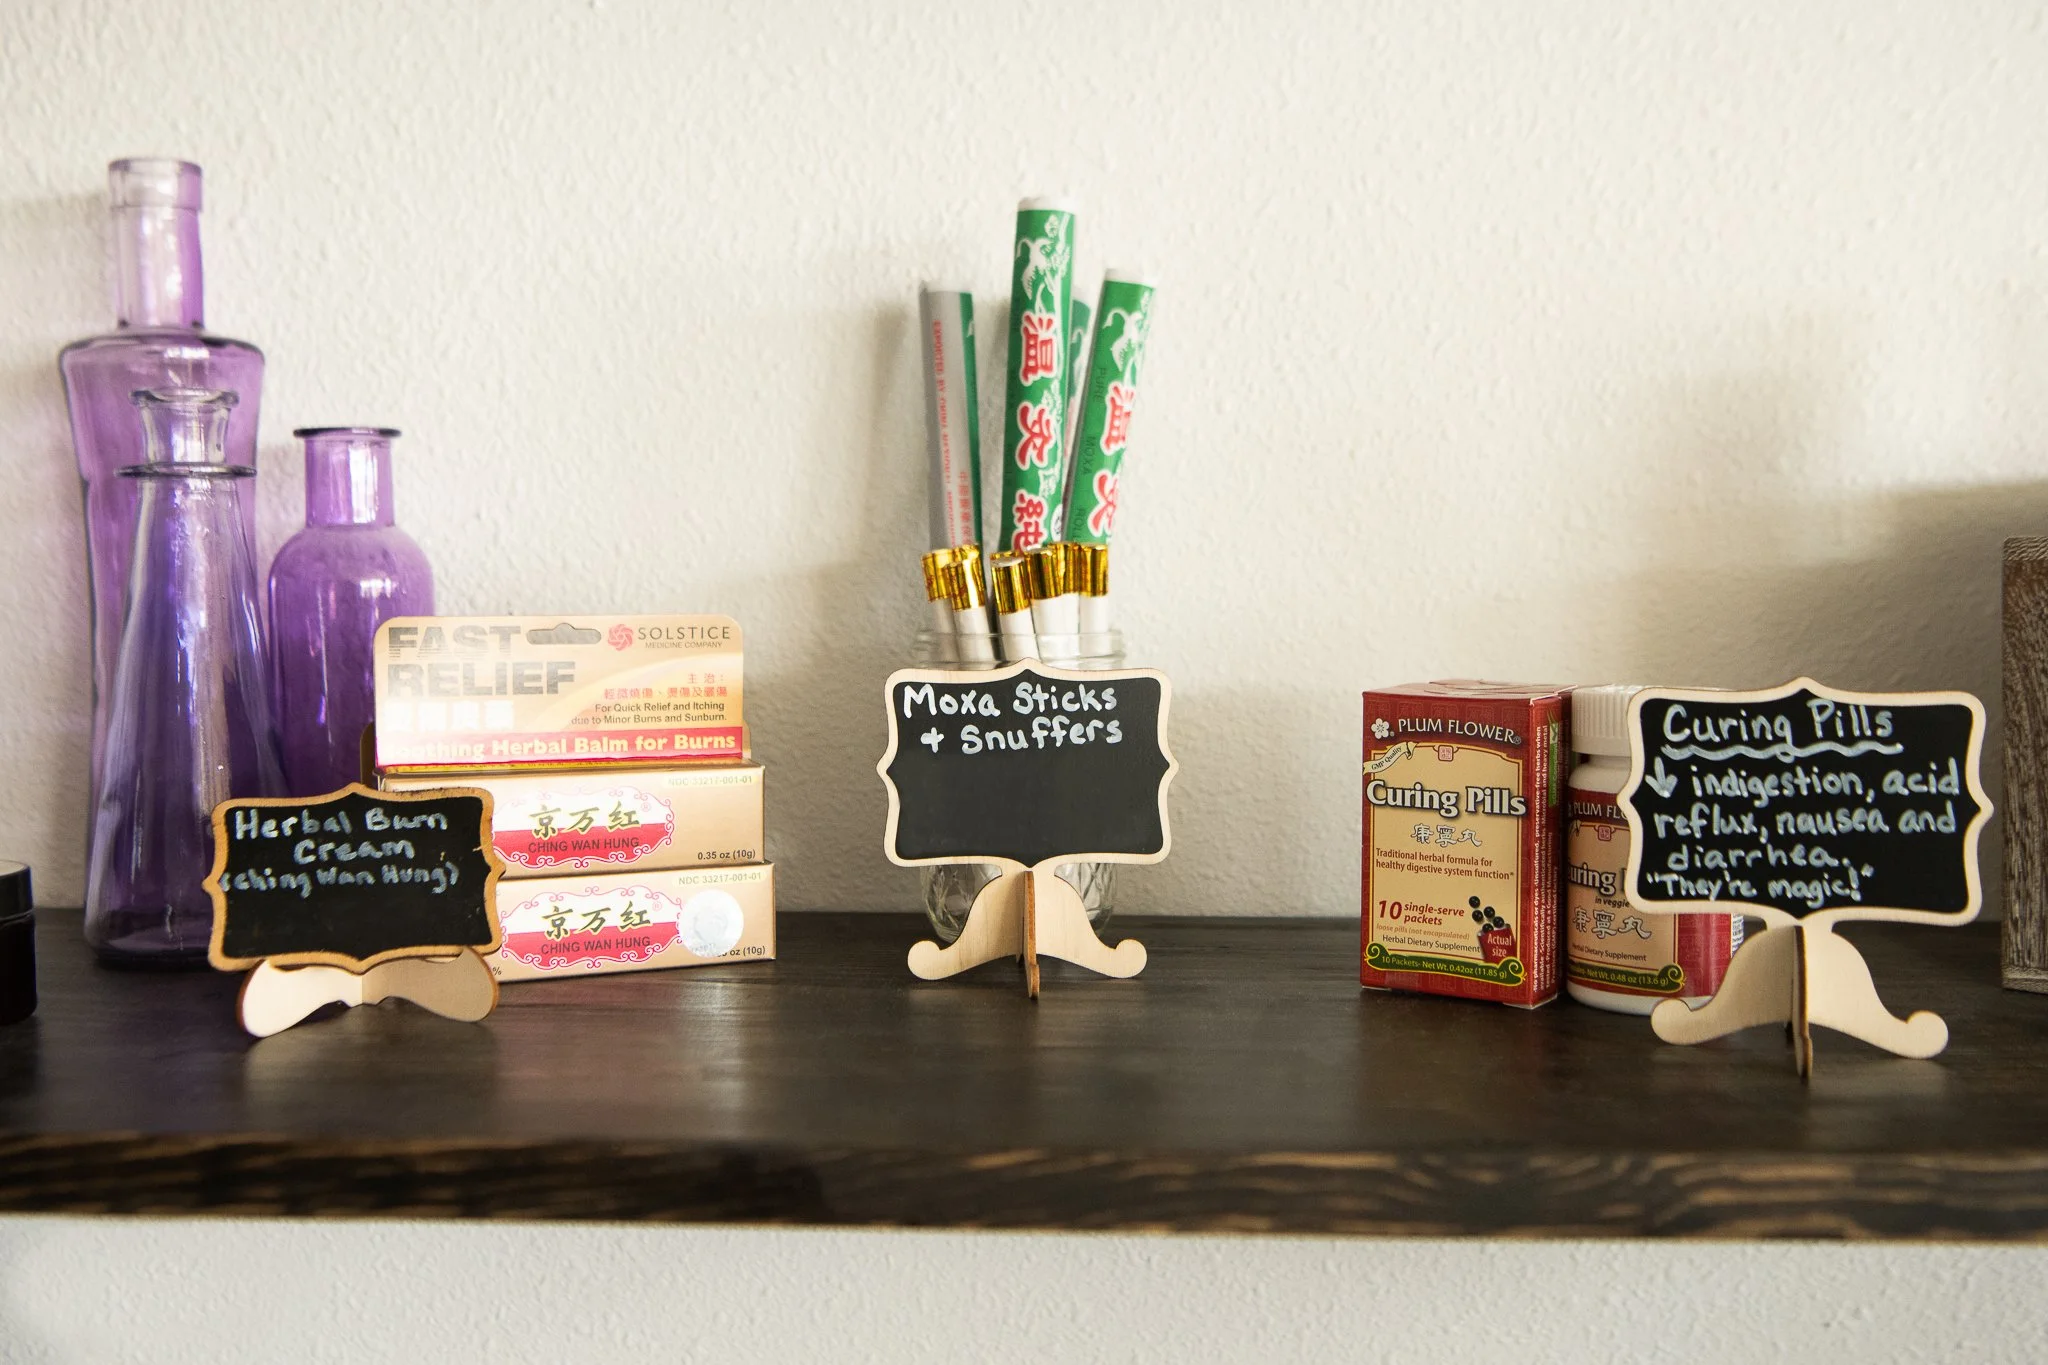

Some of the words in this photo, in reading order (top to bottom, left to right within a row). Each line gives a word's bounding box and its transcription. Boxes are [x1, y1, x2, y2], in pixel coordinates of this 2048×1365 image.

[1082, 436, 1096, 474] MOXA
[388, 624, 522, 660] FAST
[638, 626, 731, 640] SOLSTICE
[645, 641, 682, 649] MEDICINE
[684, 641, 722, 649] COMPANY
[387, 661, 576, 697] RELIEF
[595, 704, 612, 713] For
[613, 703, 641, 713] Quick
[644, 702, 671, 711] Relief
[673, 702, 690, 711] and
[693, 701, 725, 712] Itching
[903, 683, 1001, 718] Moxa
[1012, 681, 1118, 715] Sticks
[571, 715, 590, 725] due
[592, 715, 602, 724] to
[604, 714, 631, 724] Minor
[633, 714, 662, 723] Burns
[664, 713, 683, 722] and
[685, 712, 727, 722] Sunburn.
[960, 715, 1123, 755] Snuffers
[1398, 718, 1442, 733] PLUM
[1448, 719, 1516, 744] FLOWER
[1663, 703, 1796, 762] Curing
[1806, 698, 1893, 739] Pills
[491, 738, 567, 756] Herbal
[574, 736, 629, 753] Balm
[635, 735, 668, 751] for
[674, 734, 736, 750] Burns
[1371, 760, 1385, 770] GMP
[1385, 746, 1402, 764] Quality
[1690, 765, 1876, 808] indigestion,
[1882, 756, 1960, 797] acid
[1366, 779, 1460, 819] Curing
[1465, 785, 1527, 817] Pills
[1573, 802, 1602, 817] PLUM
[235, 807, 353, 840] Herbal
[365, 806, 448, 832] Burn
[529, 801, 641, 839] 京万红
[1653, 802, 1769, 845] reflux,
[1776, 808, 1890, 836] nausea
[1898, 800, 1957, 834] and
[293, 838, 415, 865] Cream
[528, 841, 568, 853] CHING
[570, 839, 601, 851] WAN
[603, 837, 639, 850] HUNG
[698, 851, 717, 860] 0.35
[719, 851, 731, 860] oz
[733, 849, 756, 860] (10g)
[1376, 848, 1418, 861] Traditional
[1419, 851, 1444, 863] herbal
[1446, 854, 1479, 866] formula
[1481, 857, 1493, 867] for
[1376, 859, 1405, 873] healthy
[1406, 862, 1442, 875] digestive
[1443, 867, 1473, 877] system
[678, 876, 699, 885] NDC
[702, 872, 761, 884] 33217-001-01
[1567, 862, 1617, 896] uring
[1378, 900, 1402, 920] 10
[1403, 902, 1465, 917] single-serve
[1603, 898, 1630, 908] veggie
[542, 900, 651, 940] 京万红
[1403, 914, 1443, 926] packets
[1376, 923, 1393, 932] loose
[1395, 925, 1408, 934] pills
[1408, 926, 1422, 935] (not
[1423, 928, 1470, 940] encapsulated)
[1487, 933, 1512, 946] Actual
[541, 942, 580, 955] CHING
[583, 938, 612, 951] WAN
[615, 936, 651, 950] HUNG
[743, 945, 766, 957] (10g)
[1382, 934, 1406, 944] Herbal
[1407, 937, 1434, 949] Dietary
[1435, 940, 1480, 953] Supplement
[1492, 947, 1507, 957] size
[1585, 946, 1604, 957] Dietary
[1605, 950, 1647, 961] Supplement
[1381, 956, 1391, 964] 10
[1422, 961, 1436, 969] Net
[1436, 962, 1449, 971] Wt.
[1449, 964, 1473, 974] 0.42oz
[1474, 967, 1497, 977] (11.85
[1499, 970, 1507, 980] g)
